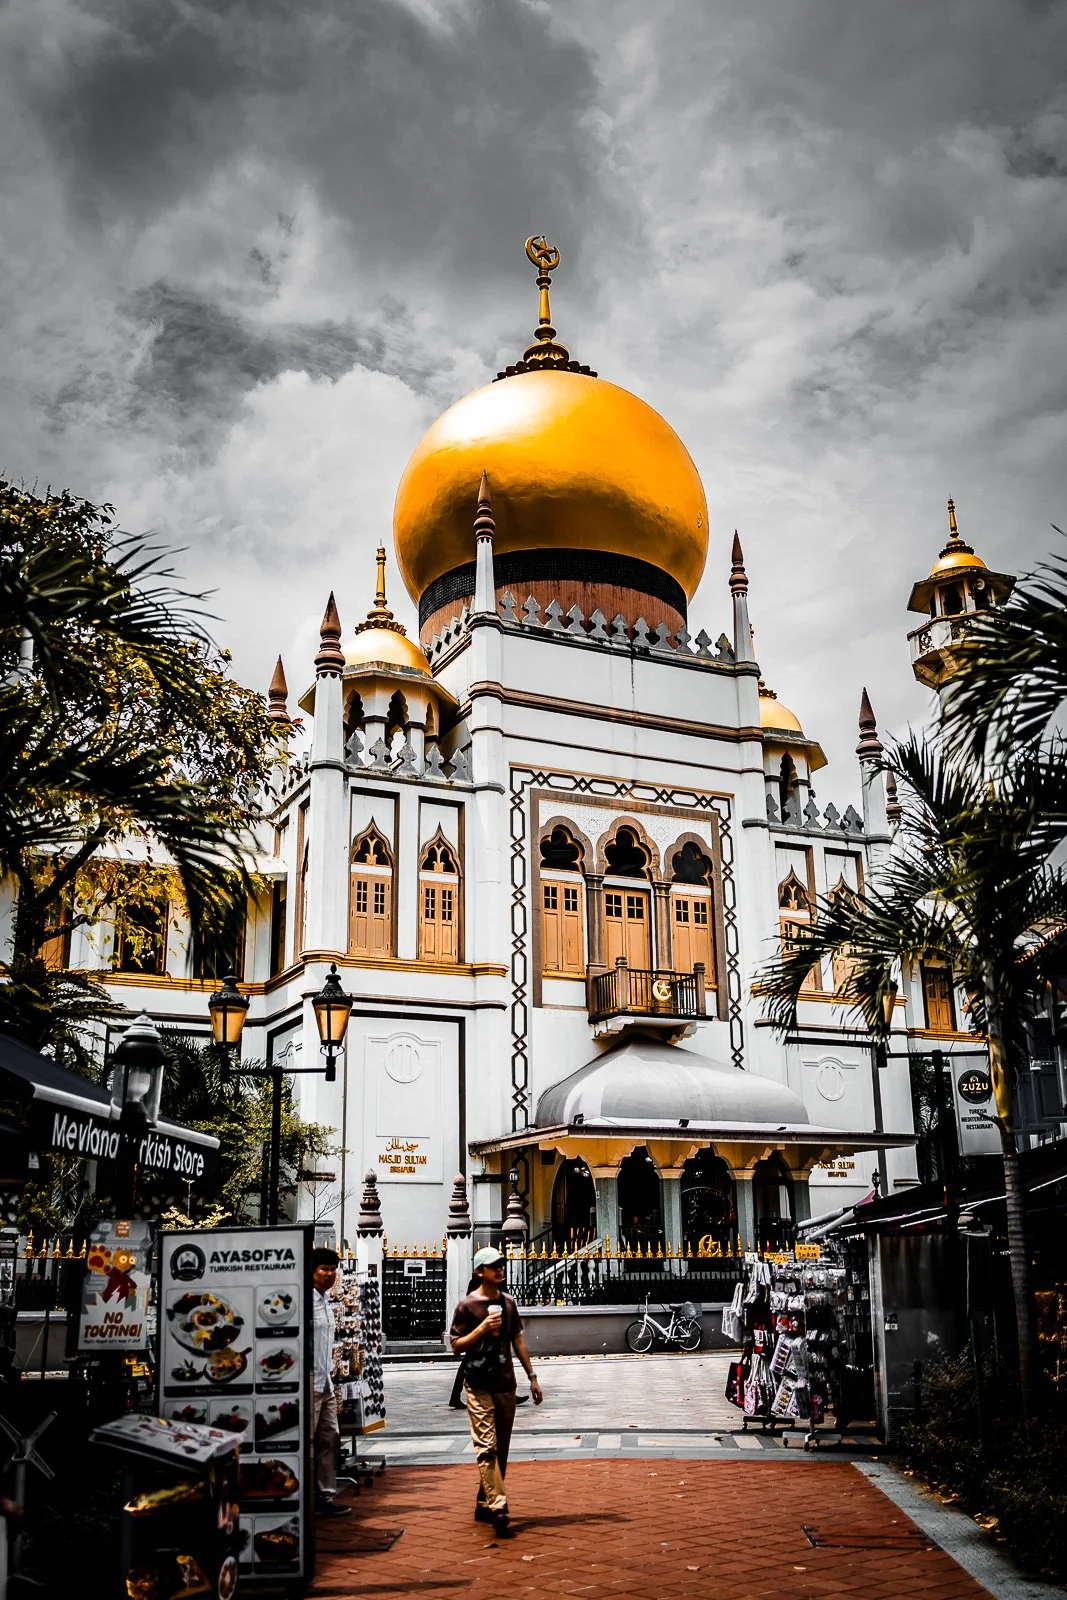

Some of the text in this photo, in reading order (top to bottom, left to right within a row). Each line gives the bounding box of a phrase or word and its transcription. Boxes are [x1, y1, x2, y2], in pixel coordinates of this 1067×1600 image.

[961, 1083, 989, 1091] ZUZU
[52, 1113, 205, 1177] Mevlana rkish Store
[378, 1154, 427, 1165] MASJID SULTAN
[838, 1161, 855, 1169] SULTAN
[209, 1248, 296, 1264] AYASOFYA
[209, 1262, 297, 1274] TURKISH RESTAURANT
[103, 1312, 124, 1324] NO
[84, 1323, 142, 1338] TOUTING!
